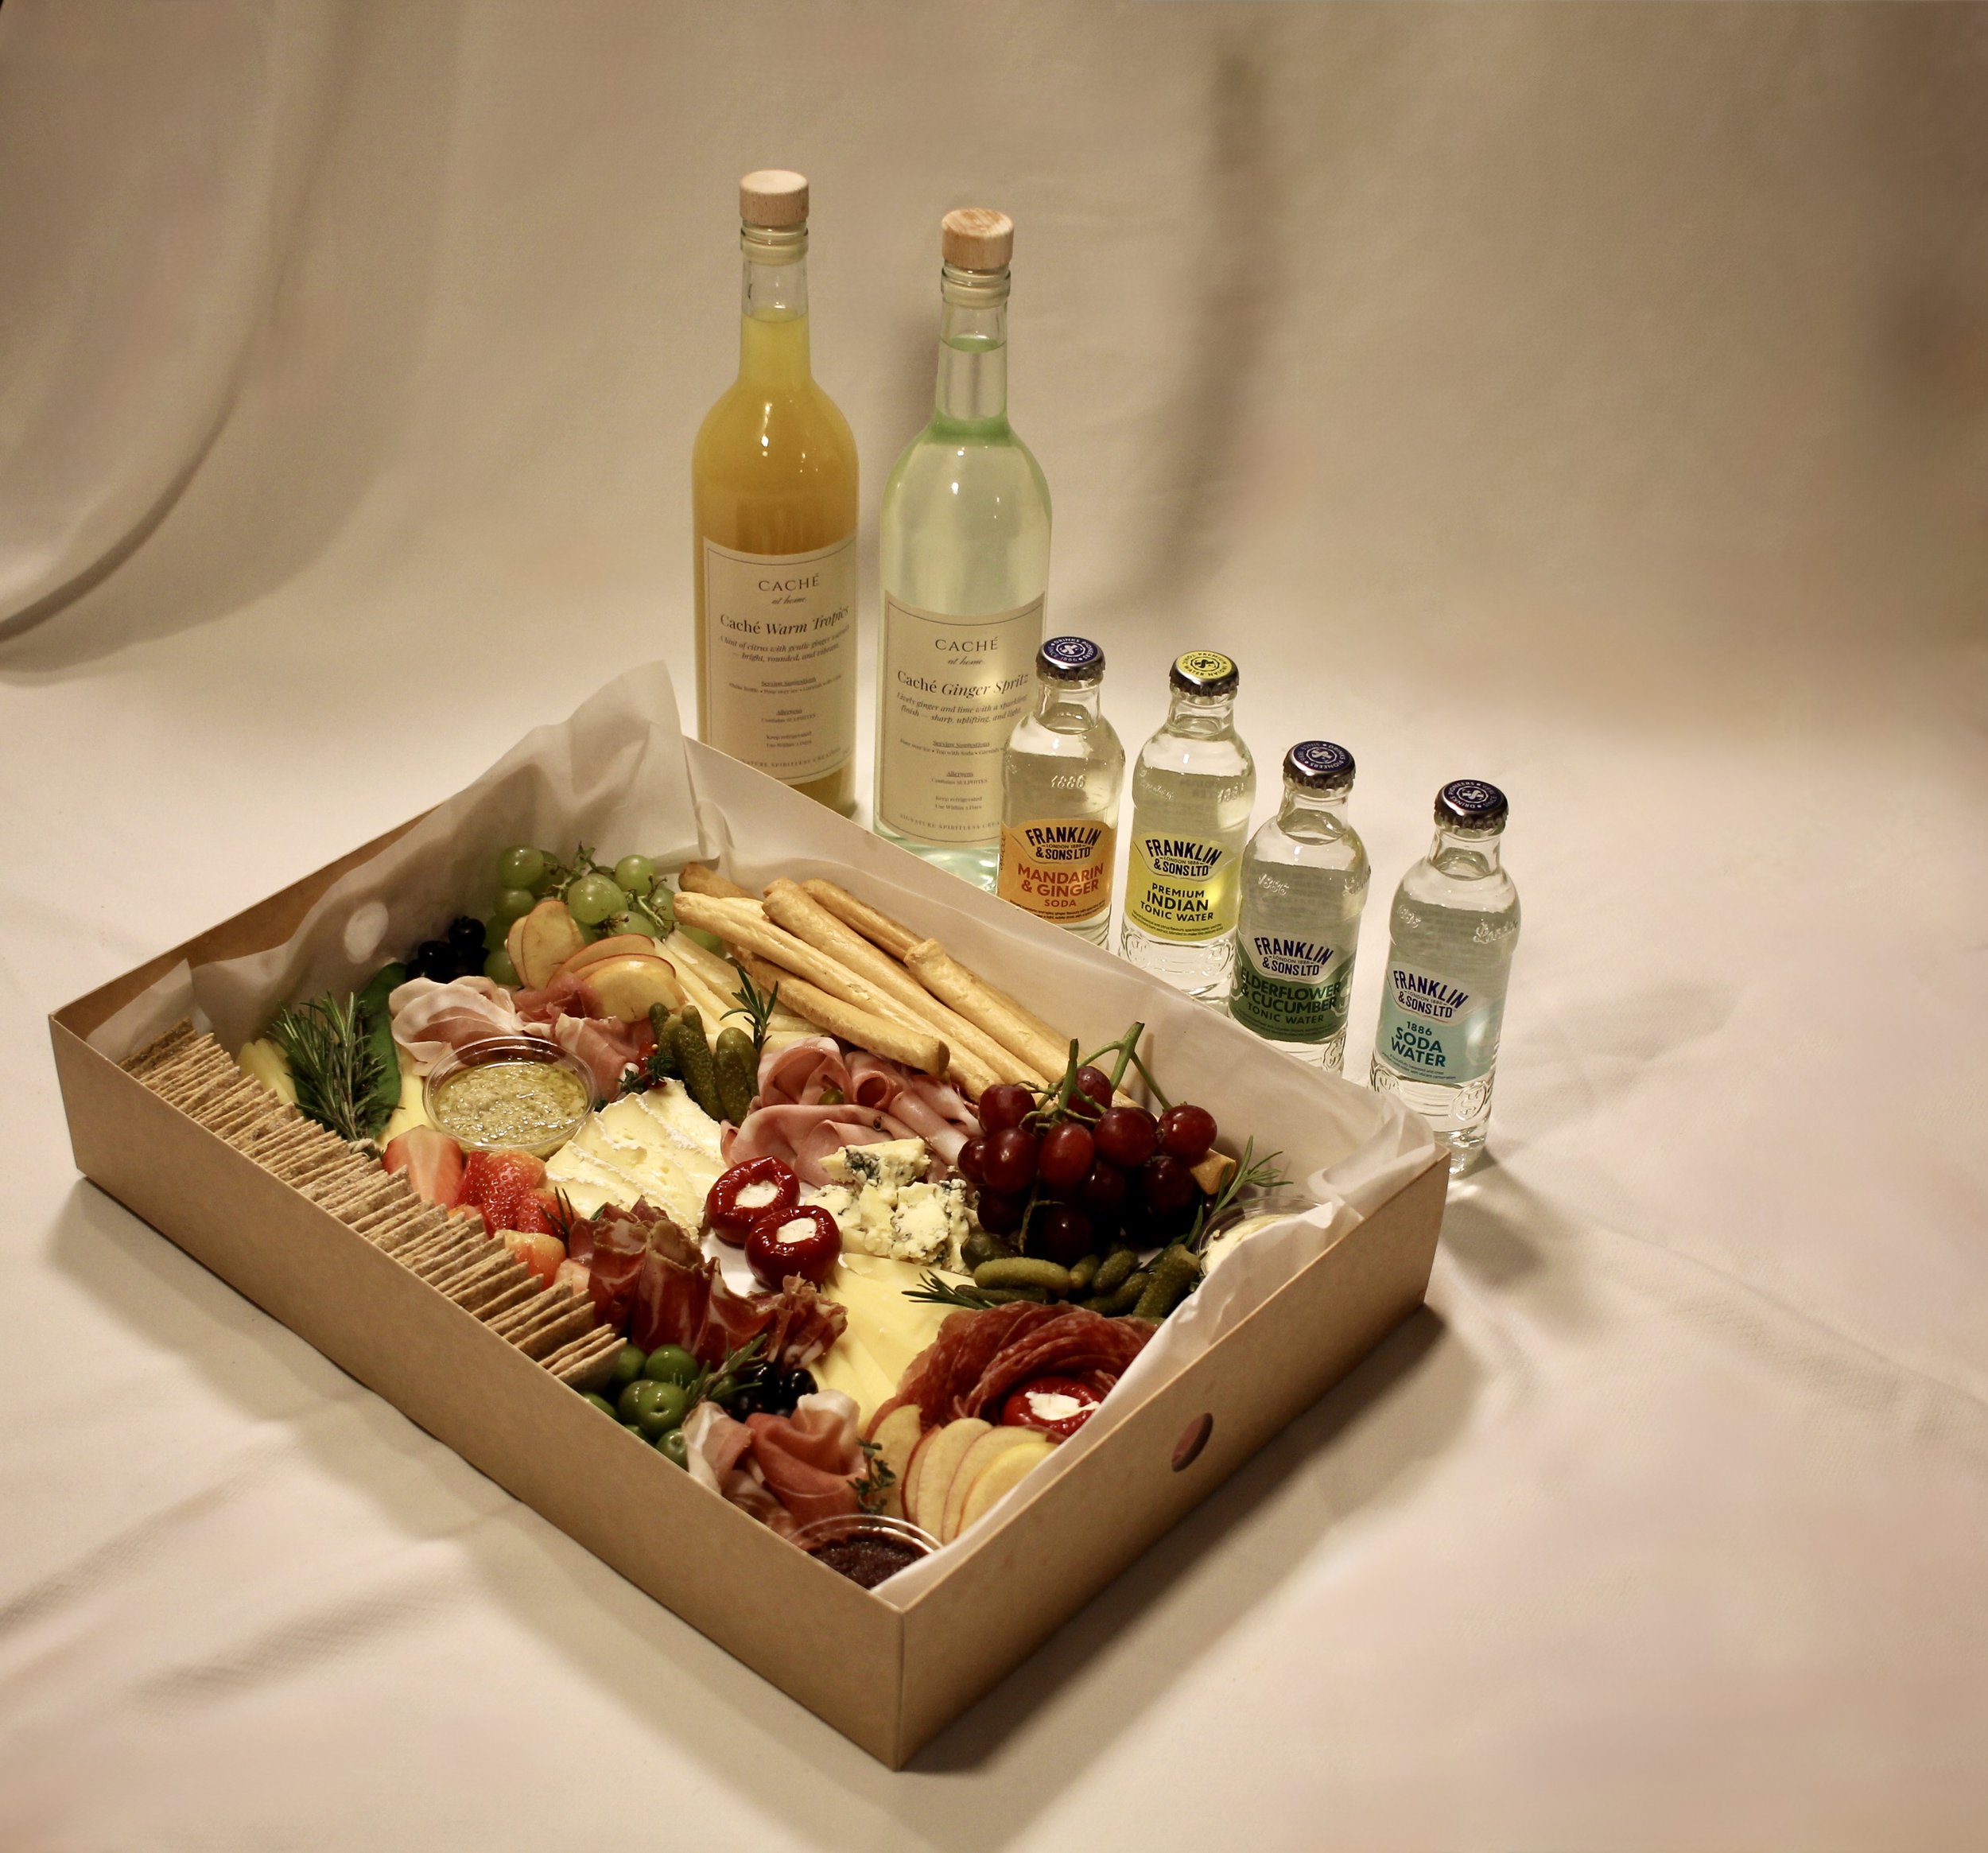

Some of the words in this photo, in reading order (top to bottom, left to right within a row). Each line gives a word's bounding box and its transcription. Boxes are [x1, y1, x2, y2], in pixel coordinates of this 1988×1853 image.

[758, 573, 820, 592] CACHÉ
[720, 614, 761, 635] Caché
[766, 623, 808, 635] Warm
[812, 606, 849, 631] Tropics
[739, 642, 747, 651] of
[747, 643, 768, 652] citrus
[770, 644, 787, 653] with
[788, 643, 810, 654] gentle
[935, 636, 999, 653] CACHÉ
[802, 651, 816, 661] and
[959, 655, 983, 666] home
[897, 670, 938, 693] Caché
[942, 683, 991, 699] Ginger
[993, 674, 1029, 695] Spritz
[896, 691, 915, 705] Lively
[916, 700, 939, 712] ginger
[940, 705, 956, 713] and
[957, 705, 974, 714] lime
[975, 703, 992, 713] with
[900, 704, 919, 717] finish
[930, 715, 954, 724] sharp,
[992, 710, 1007, 721] and
[1050, 774, 1085, 790] 1886
[1025, 826, 1102, 846] FRANKLIN
[1035, 846, 1044, 858] &
[1045, 849, 1073, 860] SONS
[1145, 839, 1222, 866] FRANKLIN
[1018, 862, 1104, 884] MANDARIN
[1154, 858, 1161, 870] &
[1162, 861, 1189, 876] SONS
[1021, 879, 1033, 893] &
[1037, 879, 1099, 898] GINGER
[1152, 882, 1205, 898] PREMIUM
[1044, 899, 1077, 907] SODA
[1140, 900, 1172, 919] TONIC
[1176, 912, 1213, 922] WATER
[1147, 891, 1209, 911] INDIAN
[1254, 937, 1334, 965] FRANKLIN
[1273, 955, 1296, 964] LONDON
[1262, 957, 1270, 969] &
[1272, 960, 1299, 976] SONS
[1241, 966, 1342, 1000] ELDERFLOWER
[1393, 970, 1469, 1009] FRANKLIN
[1241, 982, 1249, 999] &
[1252, 991, 1337, 1014] CUCUMBER
[1398, 991, 1405, 1004] &
[1406, 996, 1432, 1015] SONS
[1408, 991, 1429, 1002] LONDON
[1248, 1002, 1280, 1023] TONIC
[1285, 1014, 1324, 1024] WATER
[1407, 1021, 1432, 1036] 1886
[1396, 1027, 1442, 1053] SODA
[1391, 1037, 1446, 1067] WATER
